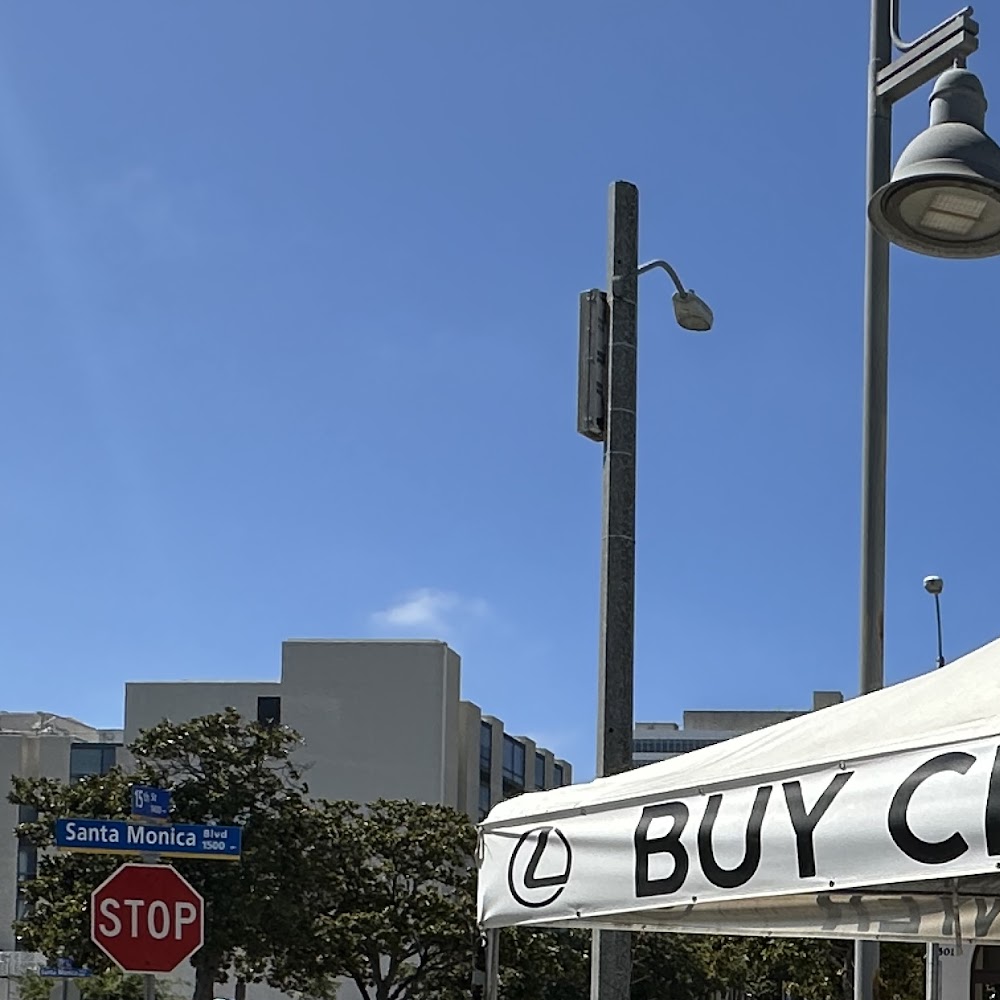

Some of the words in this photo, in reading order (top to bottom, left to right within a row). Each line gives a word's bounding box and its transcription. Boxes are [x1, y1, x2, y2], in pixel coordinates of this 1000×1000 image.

[65, 822, 120, 843] Santa
[127, 825, 197, 847] Monica
[202, 841, 226, 851] 1500
[203, 829, 228, 839] Blvd
[634, 771, 854, 898] BUY
[98, 898, 197, 940] STOP
